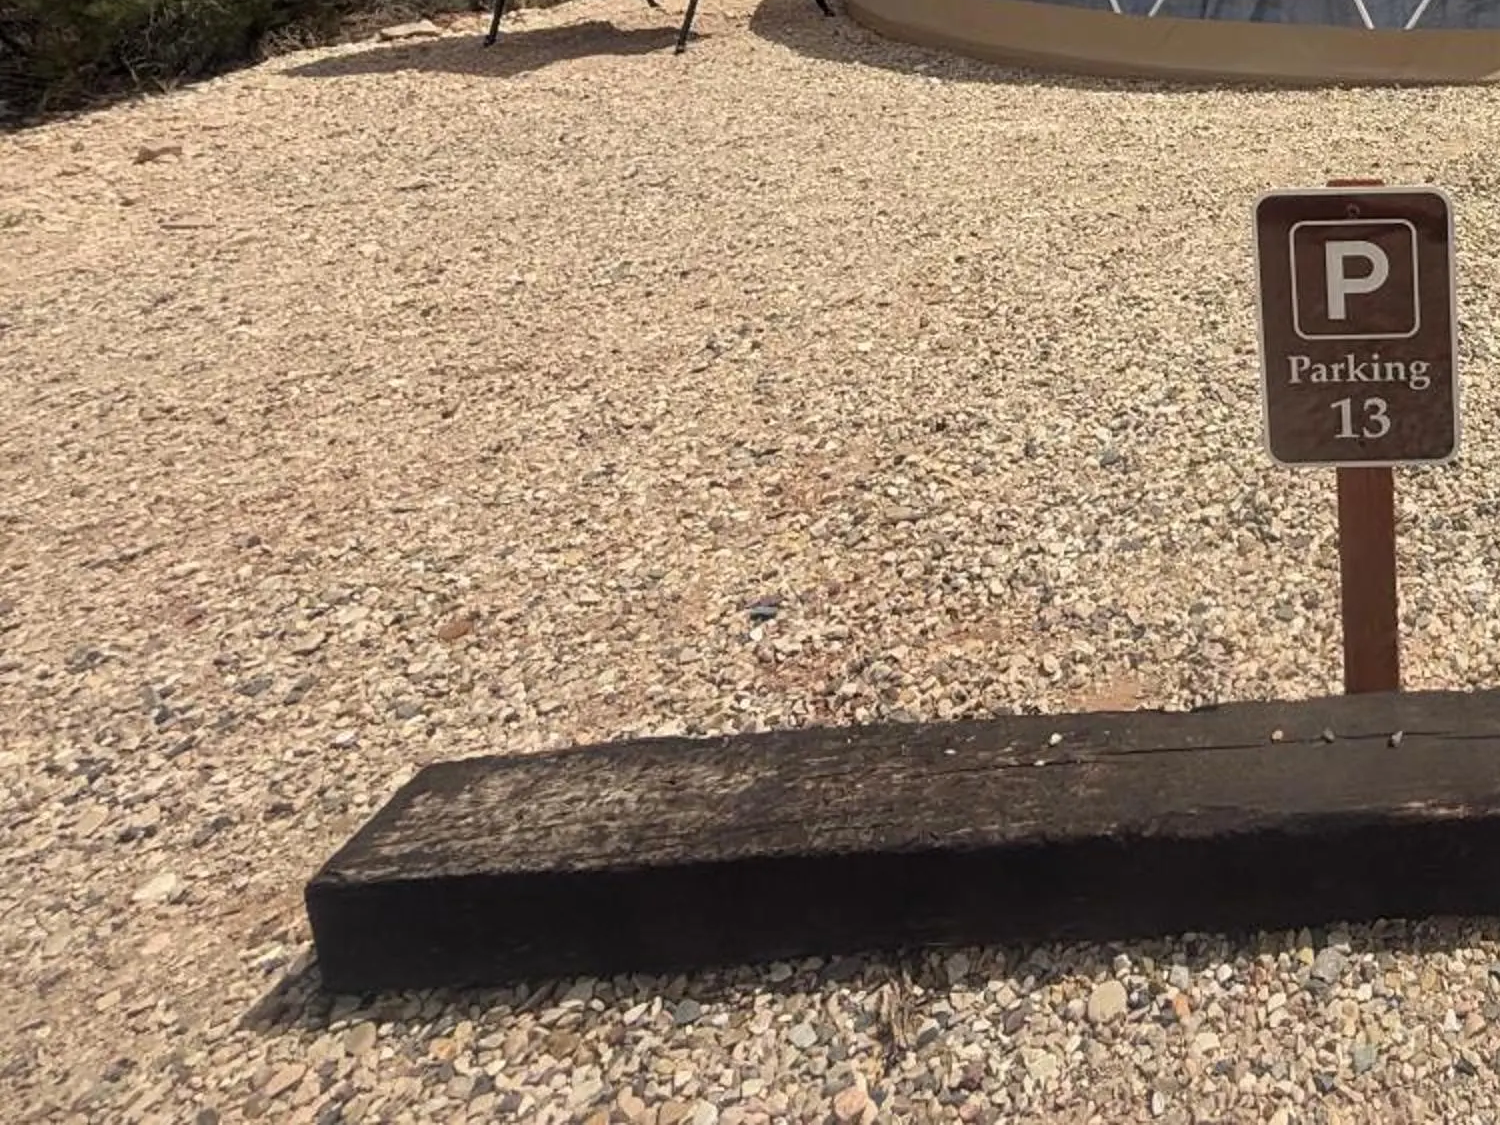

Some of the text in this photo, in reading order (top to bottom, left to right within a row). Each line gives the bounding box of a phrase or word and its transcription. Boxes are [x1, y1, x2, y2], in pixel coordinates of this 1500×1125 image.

[1325, 240, 1389, 320] P
[1287, 353, 1431, 390] Parking
[1330, 396, 1391, 439] 13
